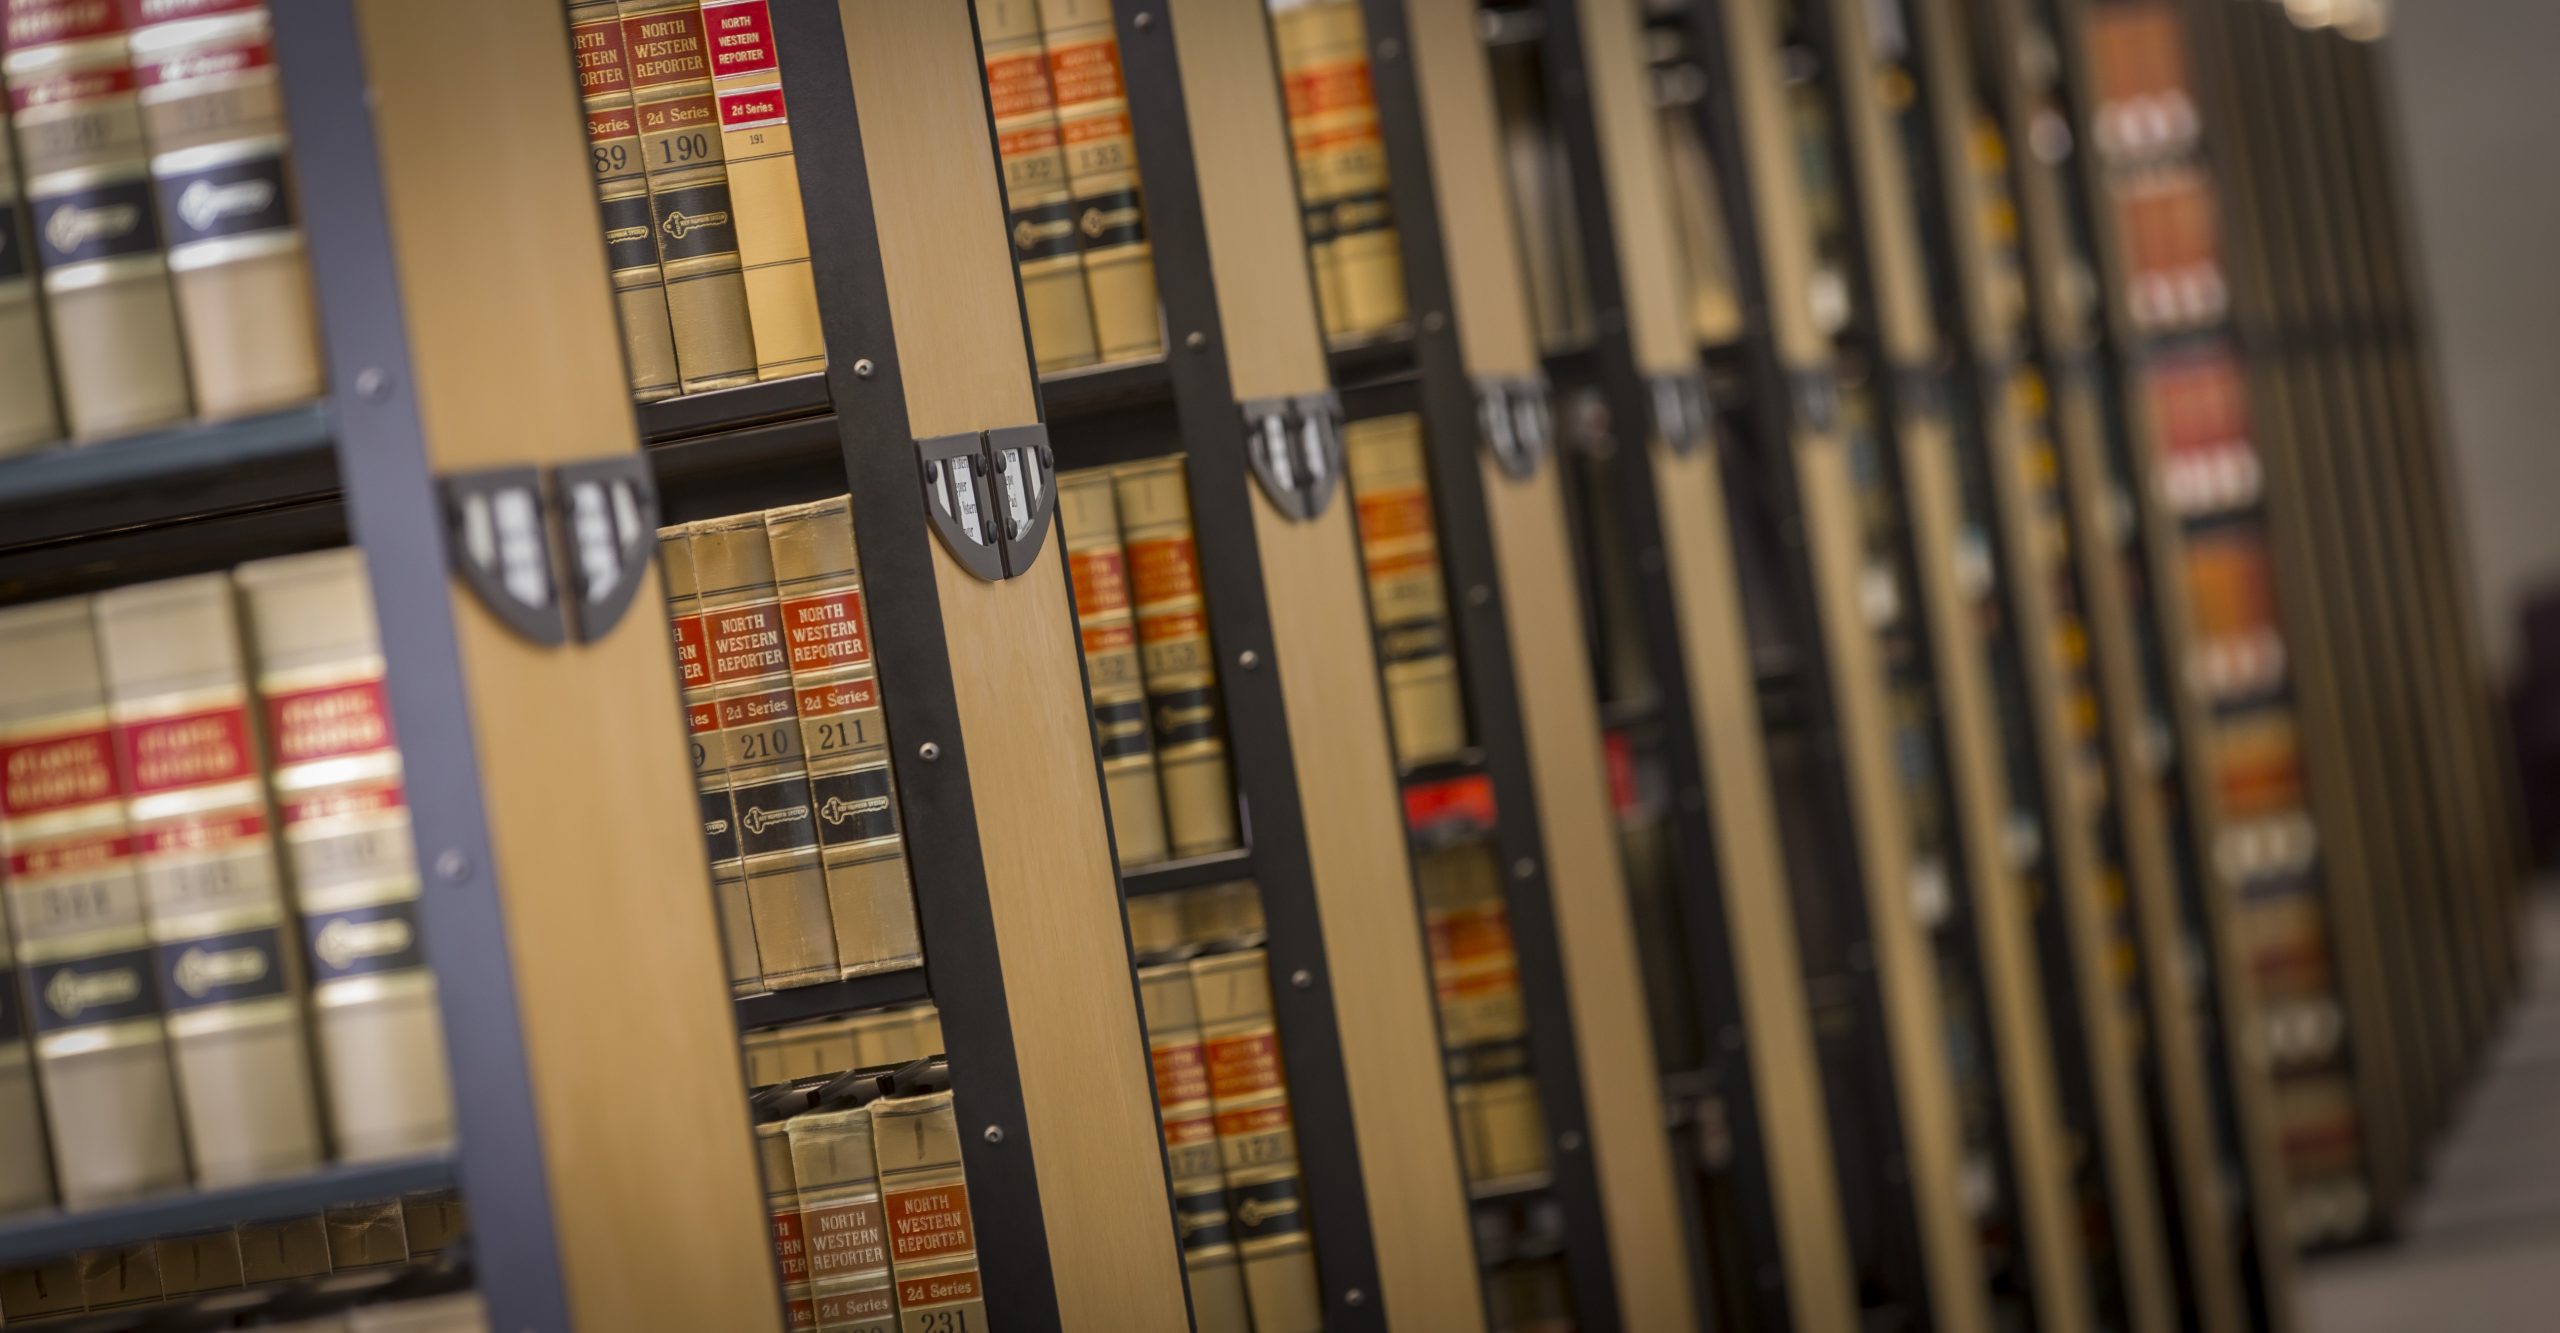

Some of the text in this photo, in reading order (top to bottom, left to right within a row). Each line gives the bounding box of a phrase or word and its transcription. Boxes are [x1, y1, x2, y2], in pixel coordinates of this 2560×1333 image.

[640, 19, 686, 39] NORTH
[721, 16, 752, 29] NORTH
[574, 32, 605, 49] RTH
[634, 37, 698, 58] WESTERN
[718, 32, 760, 47] WESTERN
[577, 49, 618, 68] STERN
[636, 56, 704, 78] REPORTER
[718, 49, 764, 64] REPORTER
[580, 68, 624, 86] ORTER
[646, 106, 710, 126] 2d Series
[731, 102, 774, 116] 2d Series
[588, 119, 630, 135] Series
[659, 133, 708, 164] 190
[749, 134, 765, 145] 191
[593, 144, 627, 173] 89
[721, 613, 765, 634] NORTH
[798, 603, 845, 624] NORTH
[716, 630, 779, 653] WESTERN
[792, 620, 857, 643] WESTERN
[718, 649, 784, 672] REPORTER
[794, 638, 864, 662] REPORTER
[726, 698, 789, 721] 2d Series
[804, 690, 870, 711] 2d Series
[689, 712, 710, 727] ies
[740, 728, 789, 760] 210
[818, 719, 867, 750] 211
[904, 1194, 950, 1214] NORTH
[820, 1211, 866, 1232] NORTH
[897, 1212, 962, 1235] WESTERN
[813, 1228, 879, 1252] WESTERN
[898, 1229, 967, 1254] REPORTER
[813, 1247, 884, 1271] REPORTER
[907, 1281, 972, 1302] 2d Series
[788, 1308, 813, 1321] ries
[821, 1298, 889, 1319] 2d Series
